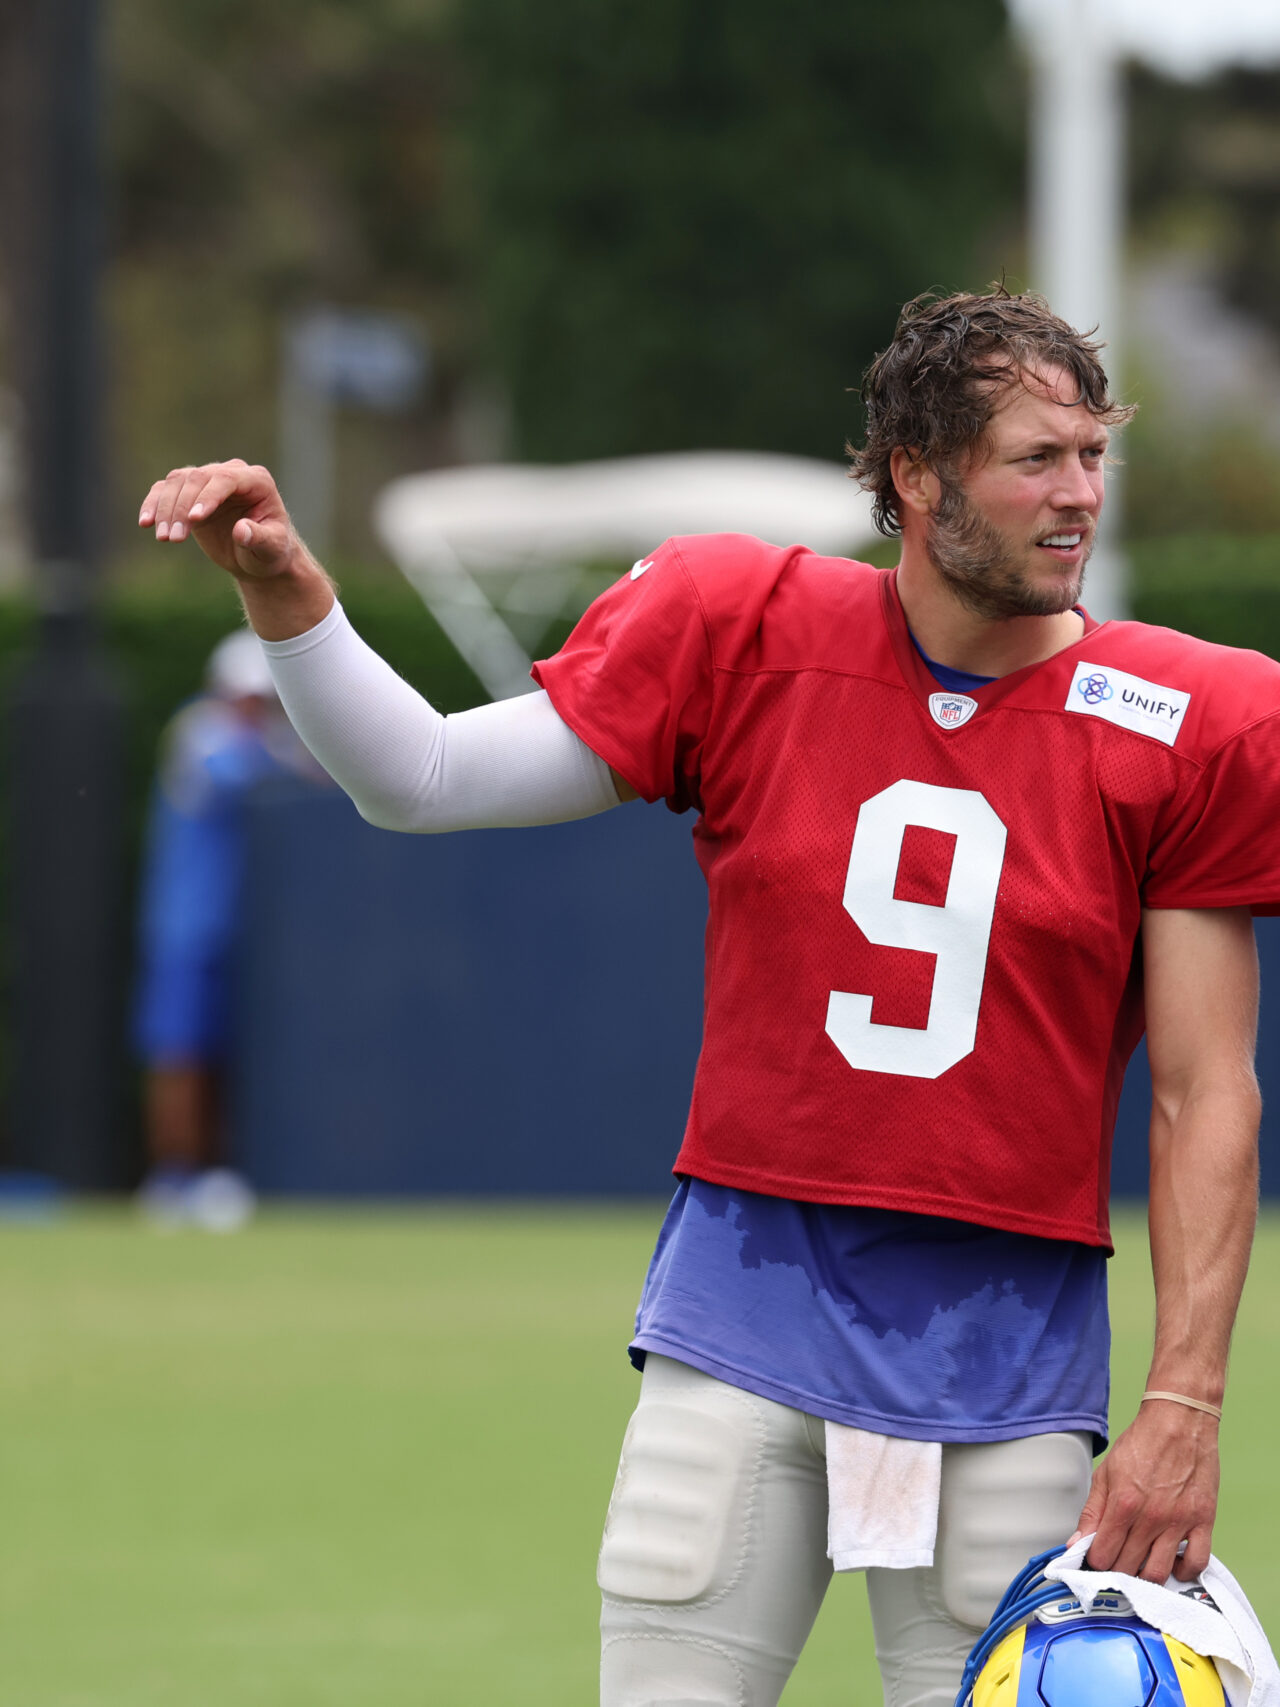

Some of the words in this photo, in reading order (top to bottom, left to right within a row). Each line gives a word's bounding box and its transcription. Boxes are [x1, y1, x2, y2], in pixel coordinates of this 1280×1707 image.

[941, 709, 960, 721] NFL
[1121, 688, 1180, 720] UNIFY
[825, 778, 1008, 1079] 9
